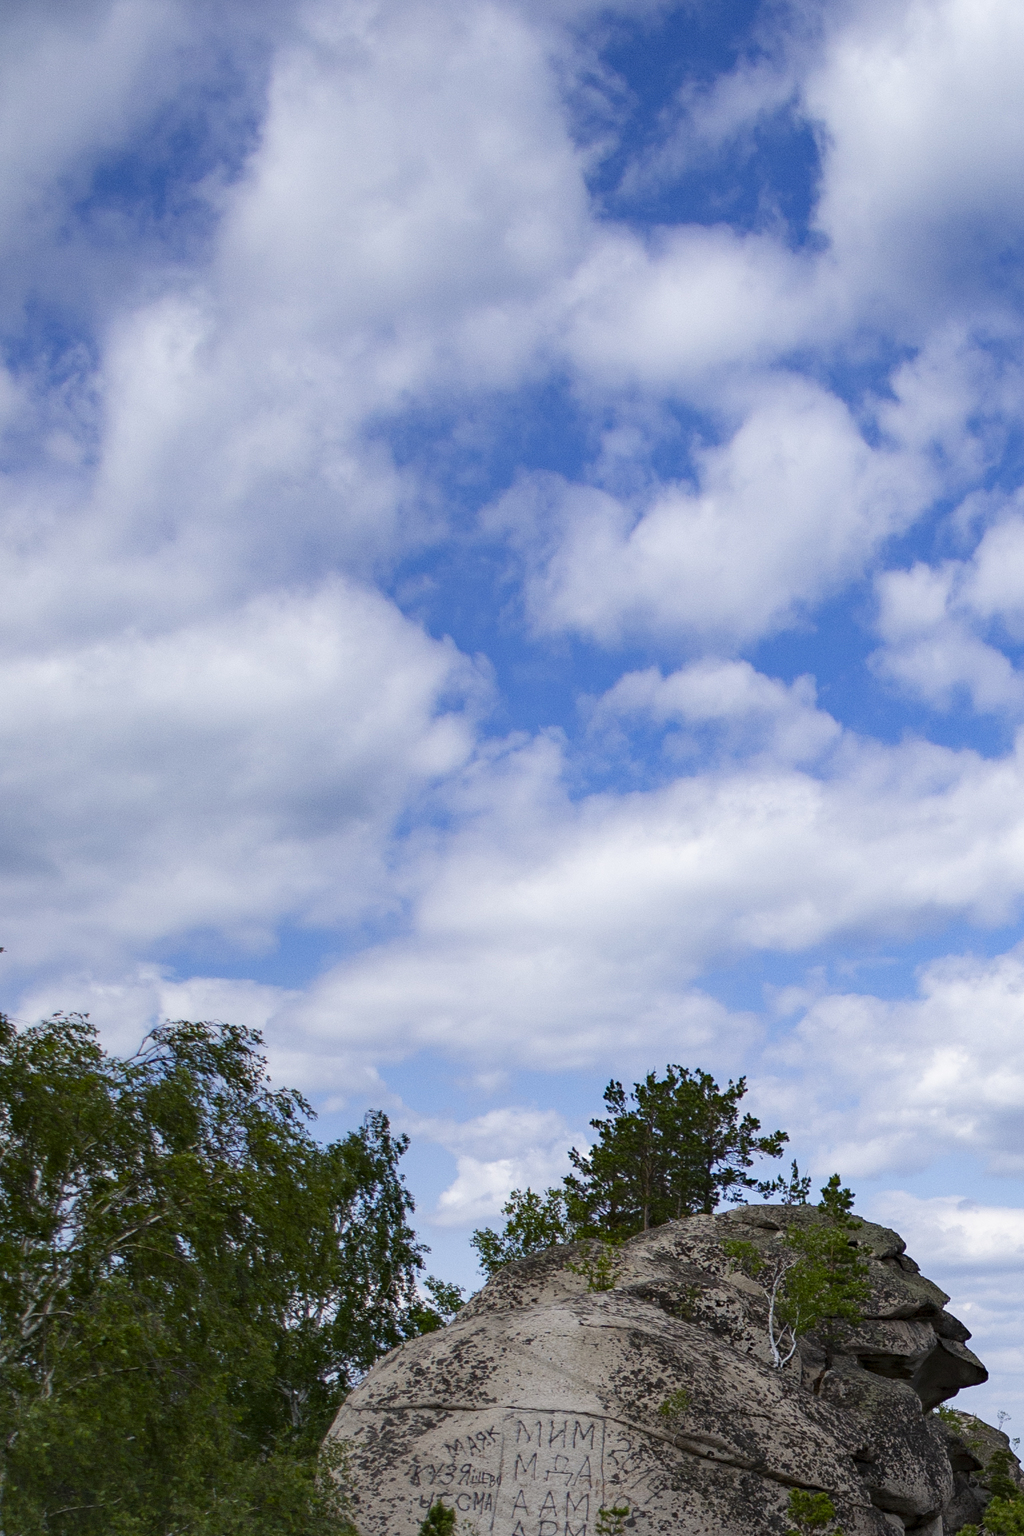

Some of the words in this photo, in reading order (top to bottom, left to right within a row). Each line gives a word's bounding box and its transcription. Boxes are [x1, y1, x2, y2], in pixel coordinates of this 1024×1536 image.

[516, 1420, 595, 1450] МИМ
[513, 1452, 592, 1489] МДА
[510, 1489, 590, 1521] ААМ
